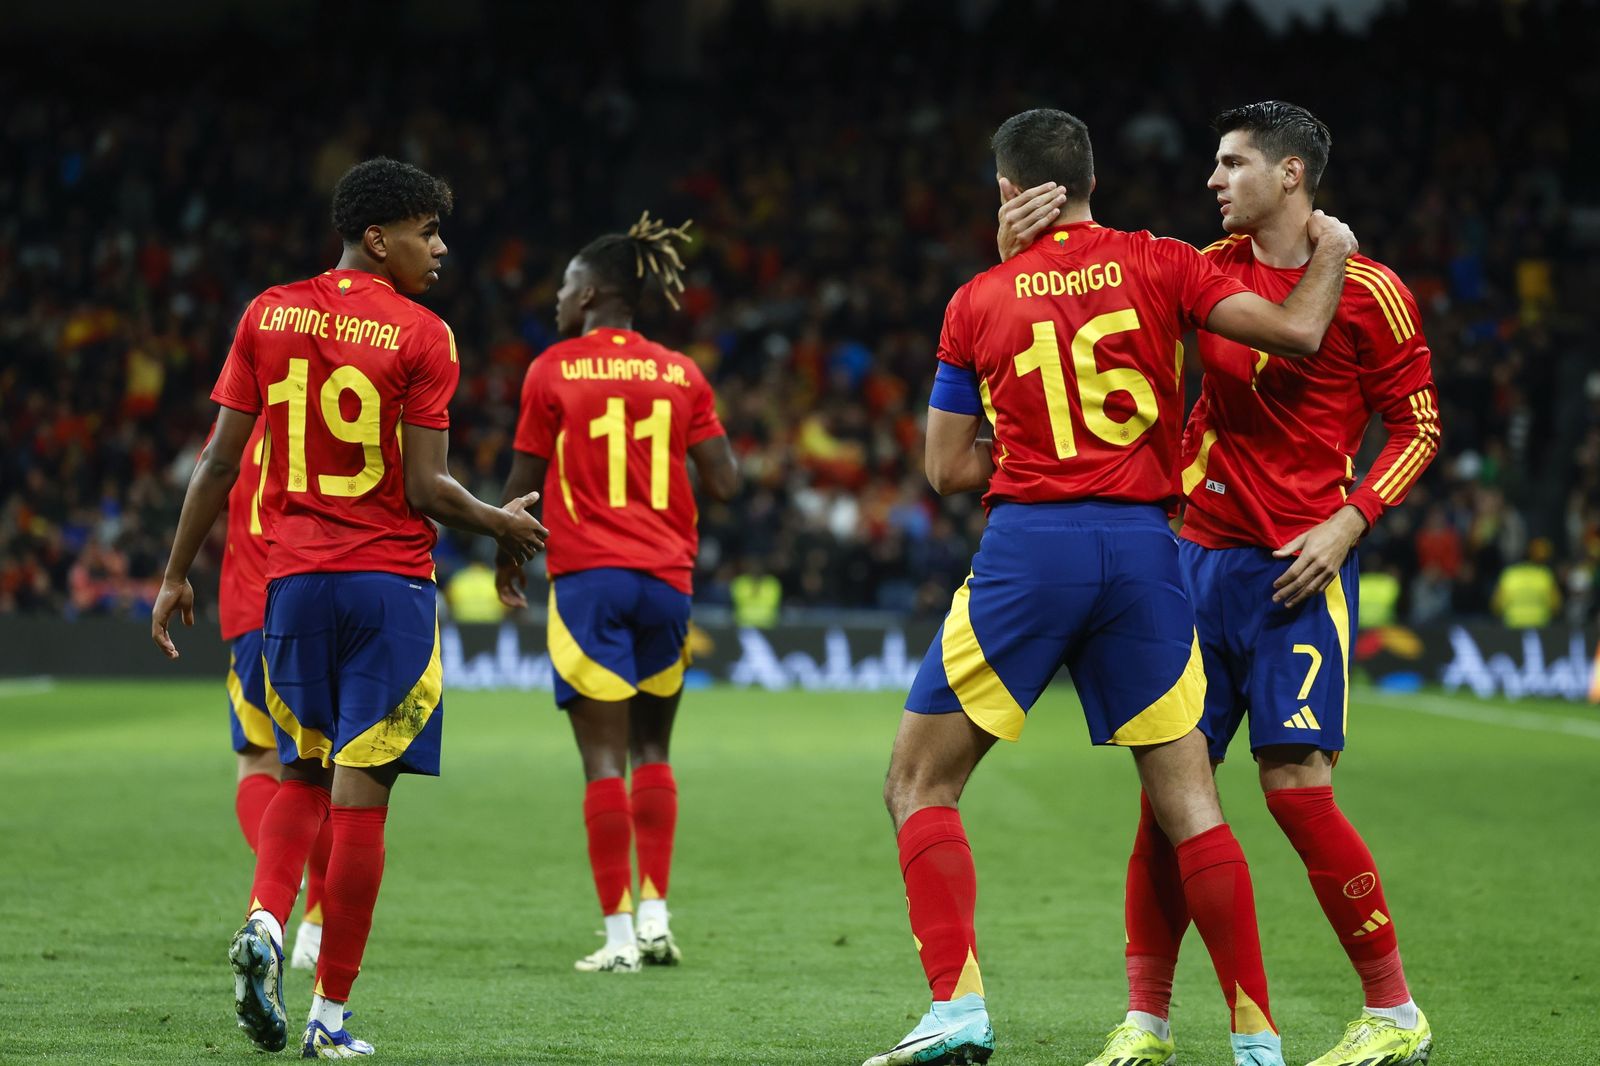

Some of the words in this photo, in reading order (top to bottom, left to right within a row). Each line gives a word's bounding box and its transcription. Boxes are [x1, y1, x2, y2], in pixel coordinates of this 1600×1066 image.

[1014, 261, 1123, 299] RODRIGO
[258, 306, 330, 339] LAMINE
[335, 314, 402, 351] YAMAL
[561, 358, 658, 381] WILLIAMS
[662, 364, 691, 387] JR.
[1013, 308, 1159, 460] 16
[267, 357, 386, 498] 19
[589, 397, 672, 510] 11
[1292, 643, 1323, 700] 7
